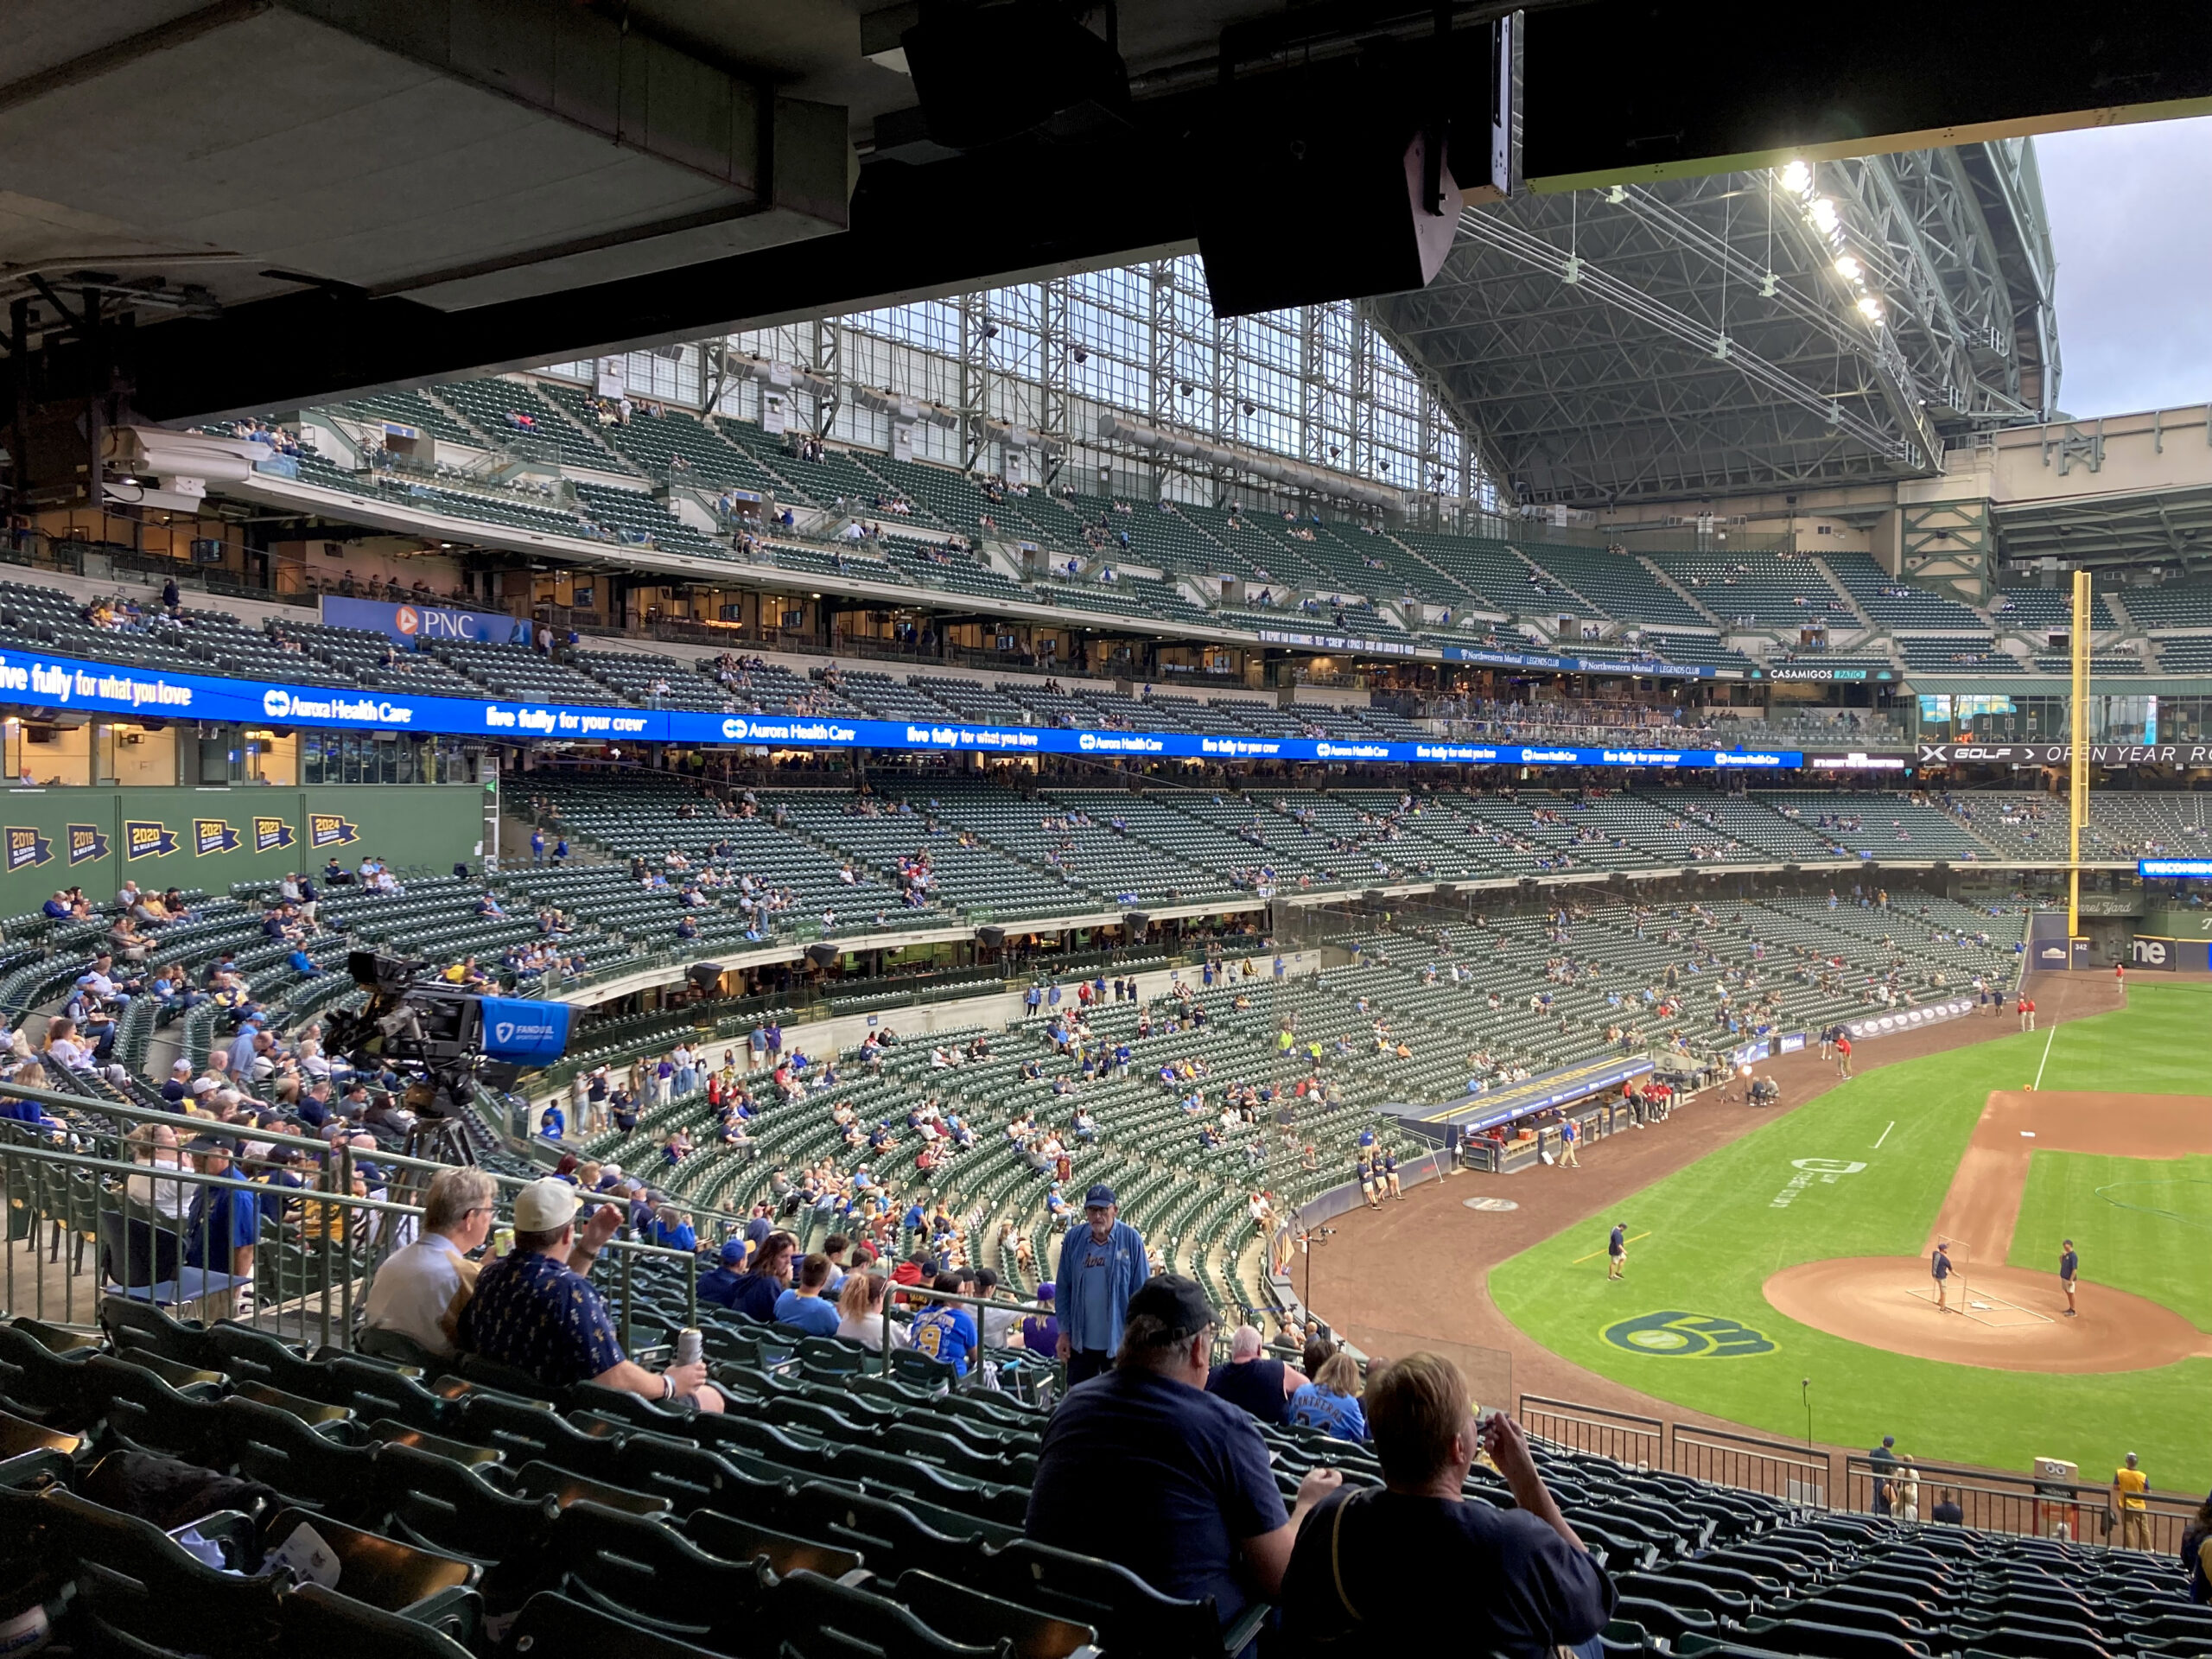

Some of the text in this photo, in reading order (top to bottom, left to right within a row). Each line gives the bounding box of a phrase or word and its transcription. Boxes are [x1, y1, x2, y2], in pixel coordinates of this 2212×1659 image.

[422, 610, 474, 639] PNC
[1468, 650, 1560, 667] Northwestern Mutual LEGENDS CLUB
[1587, 661, 1700, 675] Northwestern Mutual LEGENDS CLUB
[1770, 669, 1833, 679] CASAMIGOS
[0, 656, 29, 691] ive
[32, 663, 72, 702] fully
[76, 669, 95, 696] for
[99, 674, 130, 701] what
[133, 682, 156, 708] you
[290, 695, 412, 723] Aurora Health Care
[486, 705, 516, 728] live
[518, 709, 557, 734] fully
[559, 711, 580, 729] for
[582, 715, 611, 734] your
[748, 721, 855, 741] Aurora Health Care
[907, 726, 1039, 748] live fully for what you love
[1096, 735, 1163, 751] Aurora Health Care
[1218, 739, 1236, 755] fully
[1236, 741, 1247, 753] for
[1247, 742, 1262, 754] your
[1331, 745, 1389, 757] Aurora Health Care
[1920, 745, 1948, 761] X
[1954, 747, 2012, 760] GOLF
[2117, 747, 2177, 761] YEAR
[2190, 747, 2212, 761] R
[200, 823, 223, 838] 2021
[258, 820, 280, 835] 2023
[315, 817, 340, 833] 2024
[12, 831, 35, 849] 2018
[73, 831, 94, 849] 2019
[132, 828, 160, 844] 2020
[2102, 901, 2132, 915] Yard
[2133, 939, 2166, 964] ne
[516, 1025, 554, 1034] FANDUEL
[918, 1324, 942, 1357] 9
